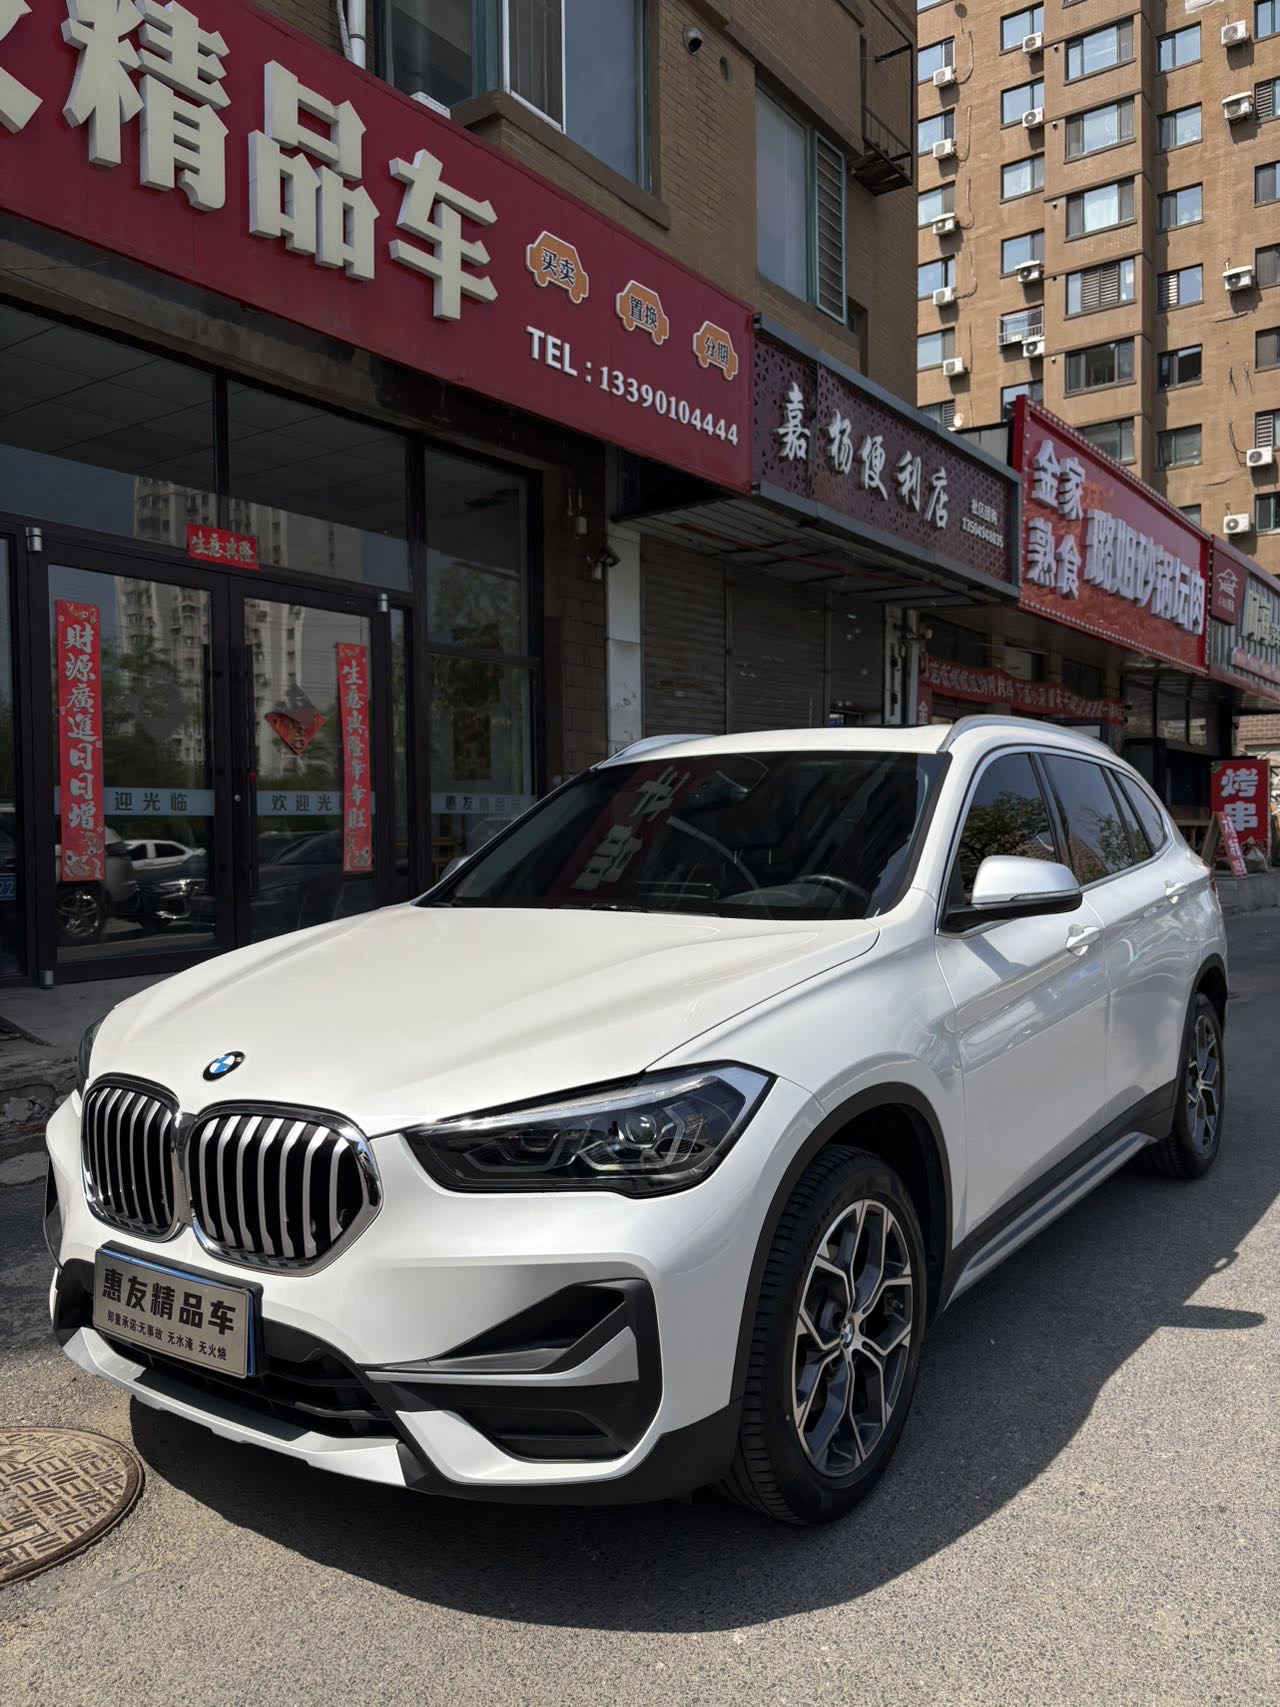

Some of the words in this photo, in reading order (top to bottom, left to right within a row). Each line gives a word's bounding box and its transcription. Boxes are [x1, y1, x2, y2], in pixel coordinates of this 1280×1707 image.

[541, 248, 576, 286] 买卖
[629, 295, 658, 329] 置换
[704, 337, 729, 366] 分期
[600, 366, 738, 446] 13390104444
[1032, 439, 1086, 521] 金家
[1027, 516, 1082, 600] 熟食
[114, 791, 188, 813] 迎光临
[272, 794, 333, 813] 欢迎光
[1220, 767, 1259, 832] 烤串
[102, 1267, 236, 1336] 惠友精品车
[167, 1331, 194, 1352] 无水淹
[198, 1341, 227, 1361] 无火烧
